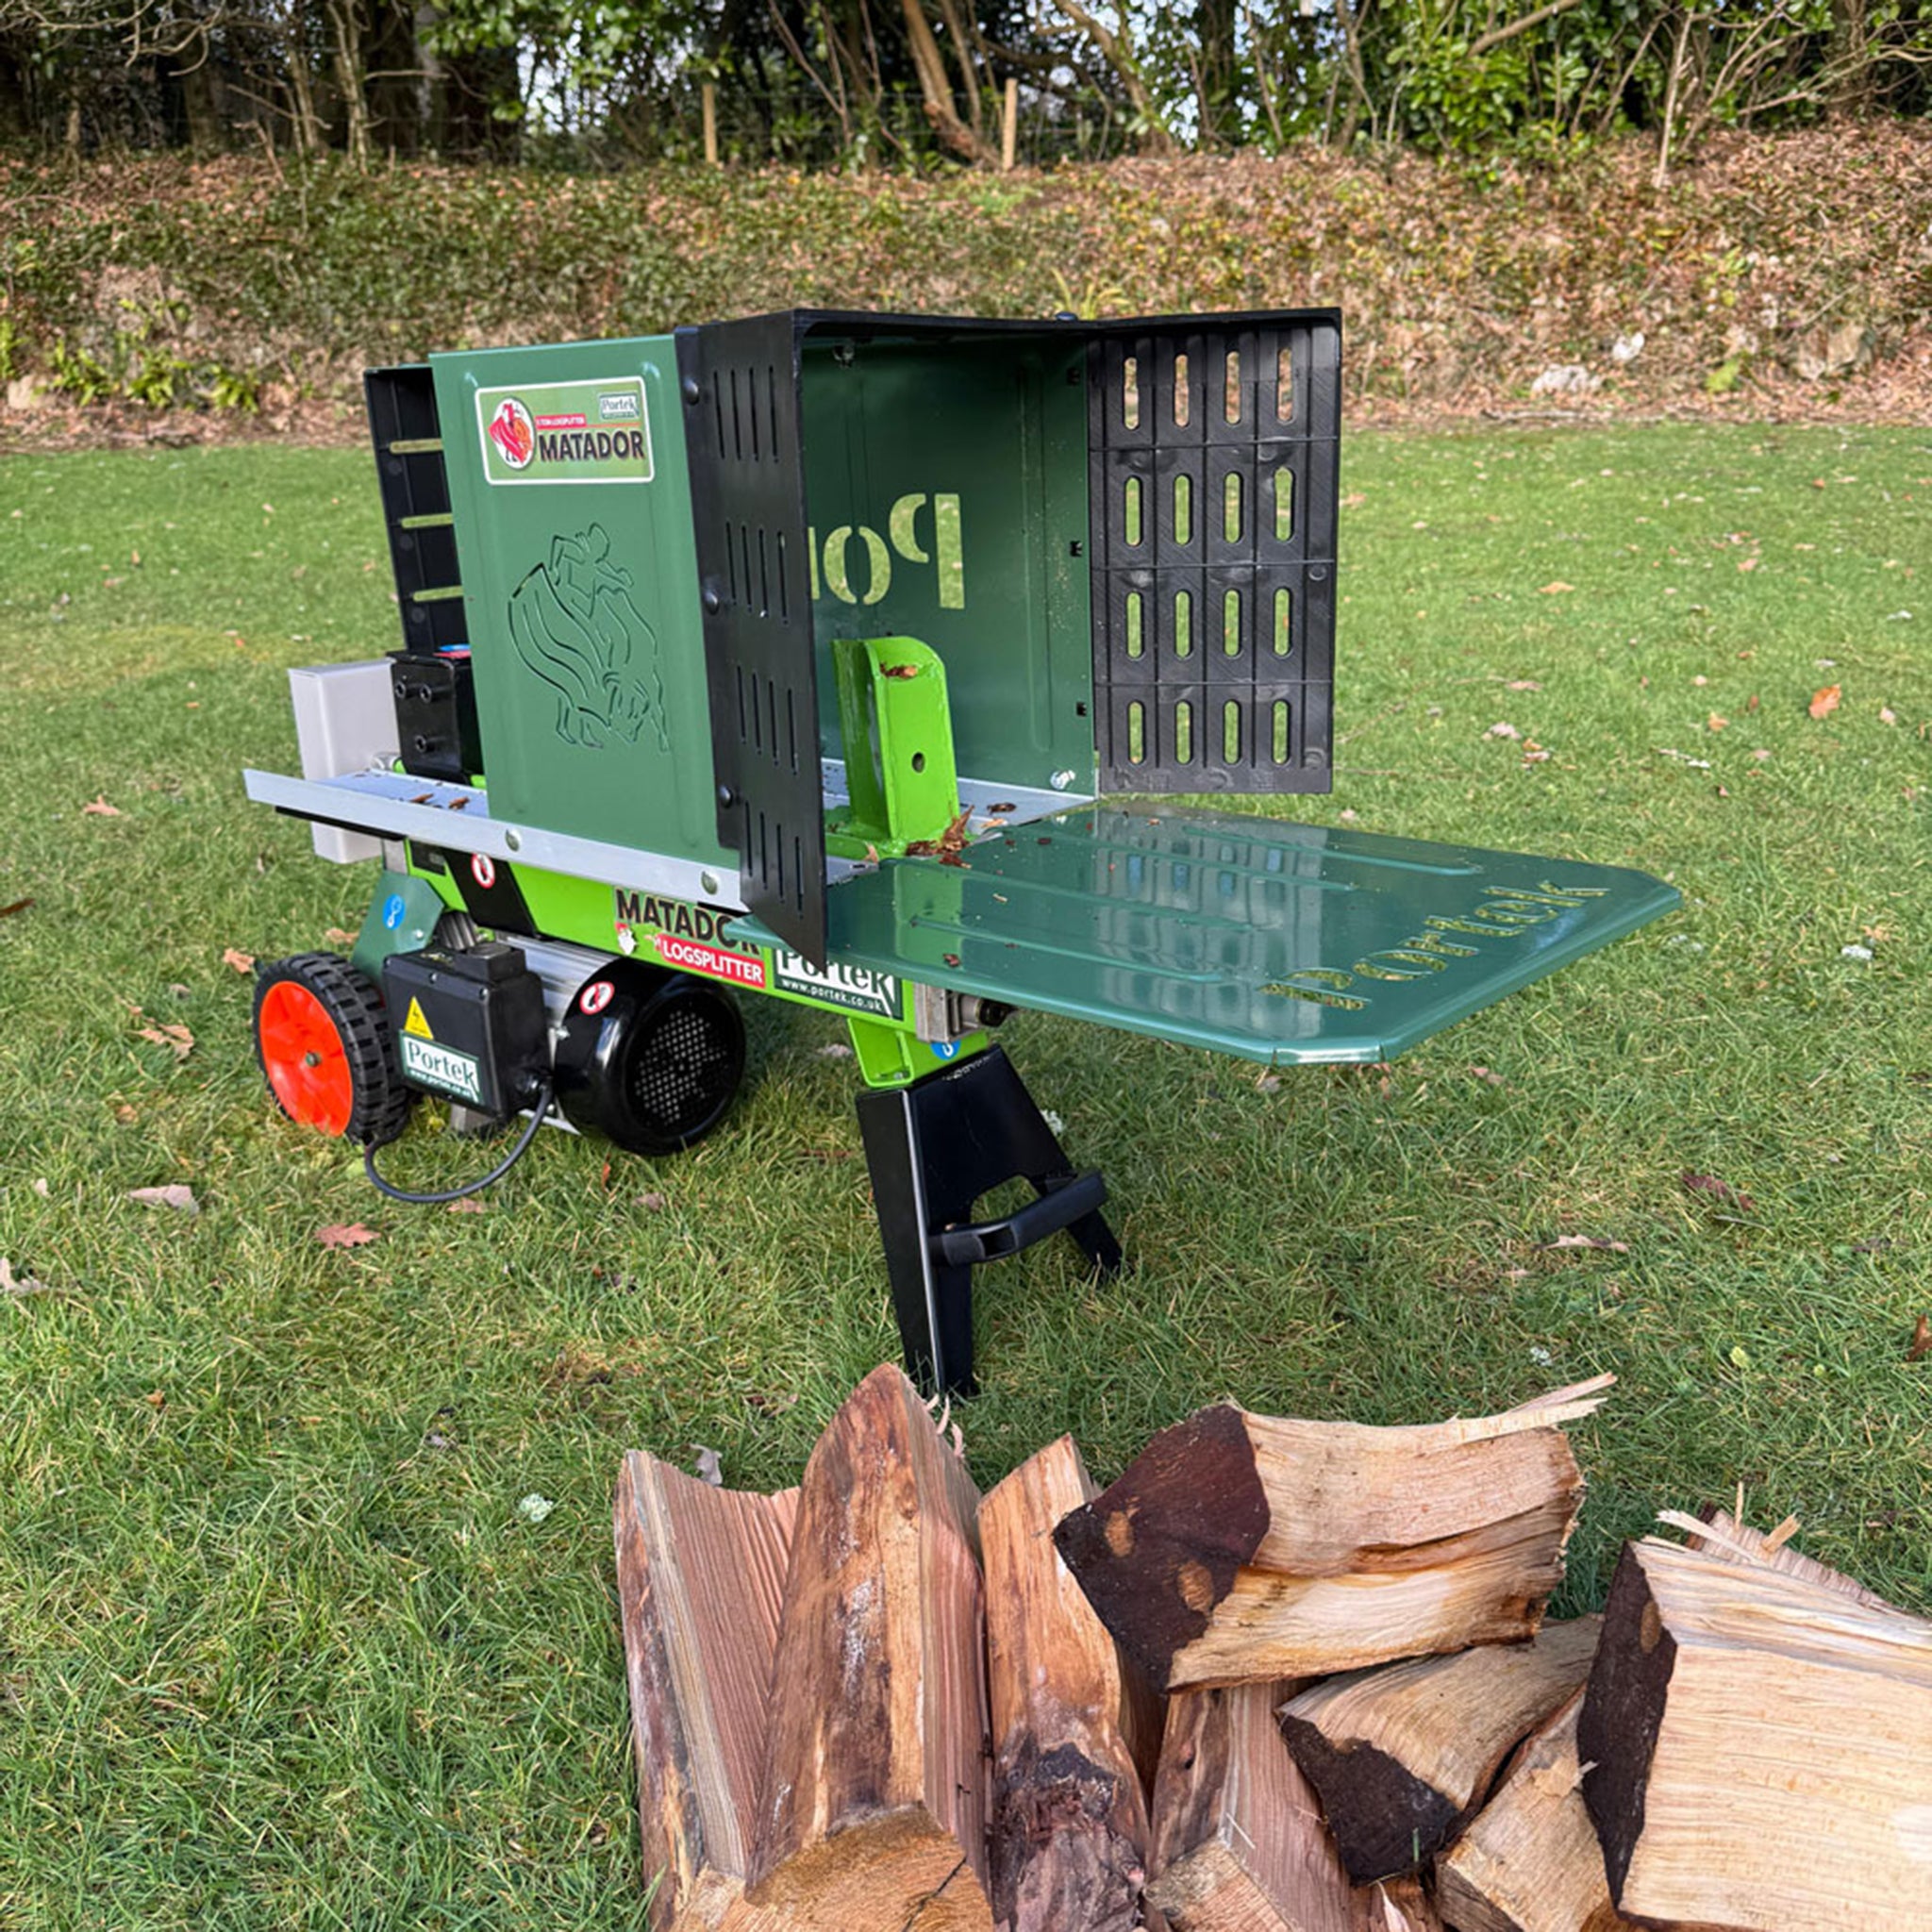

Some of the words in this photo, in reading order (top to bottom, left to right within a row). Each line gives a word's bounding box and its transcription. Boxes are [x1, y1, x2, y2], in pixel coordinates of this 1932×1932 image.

[539, 430, 644, 461] MATADOR
[663, 940, 763, 982] LOGSPLITTER
[1256, 880, 1610, 1010] Portek
[781, 978, 881, 1010] www.portek.co.uk
[408, 1041, 476, 1088] Portek
